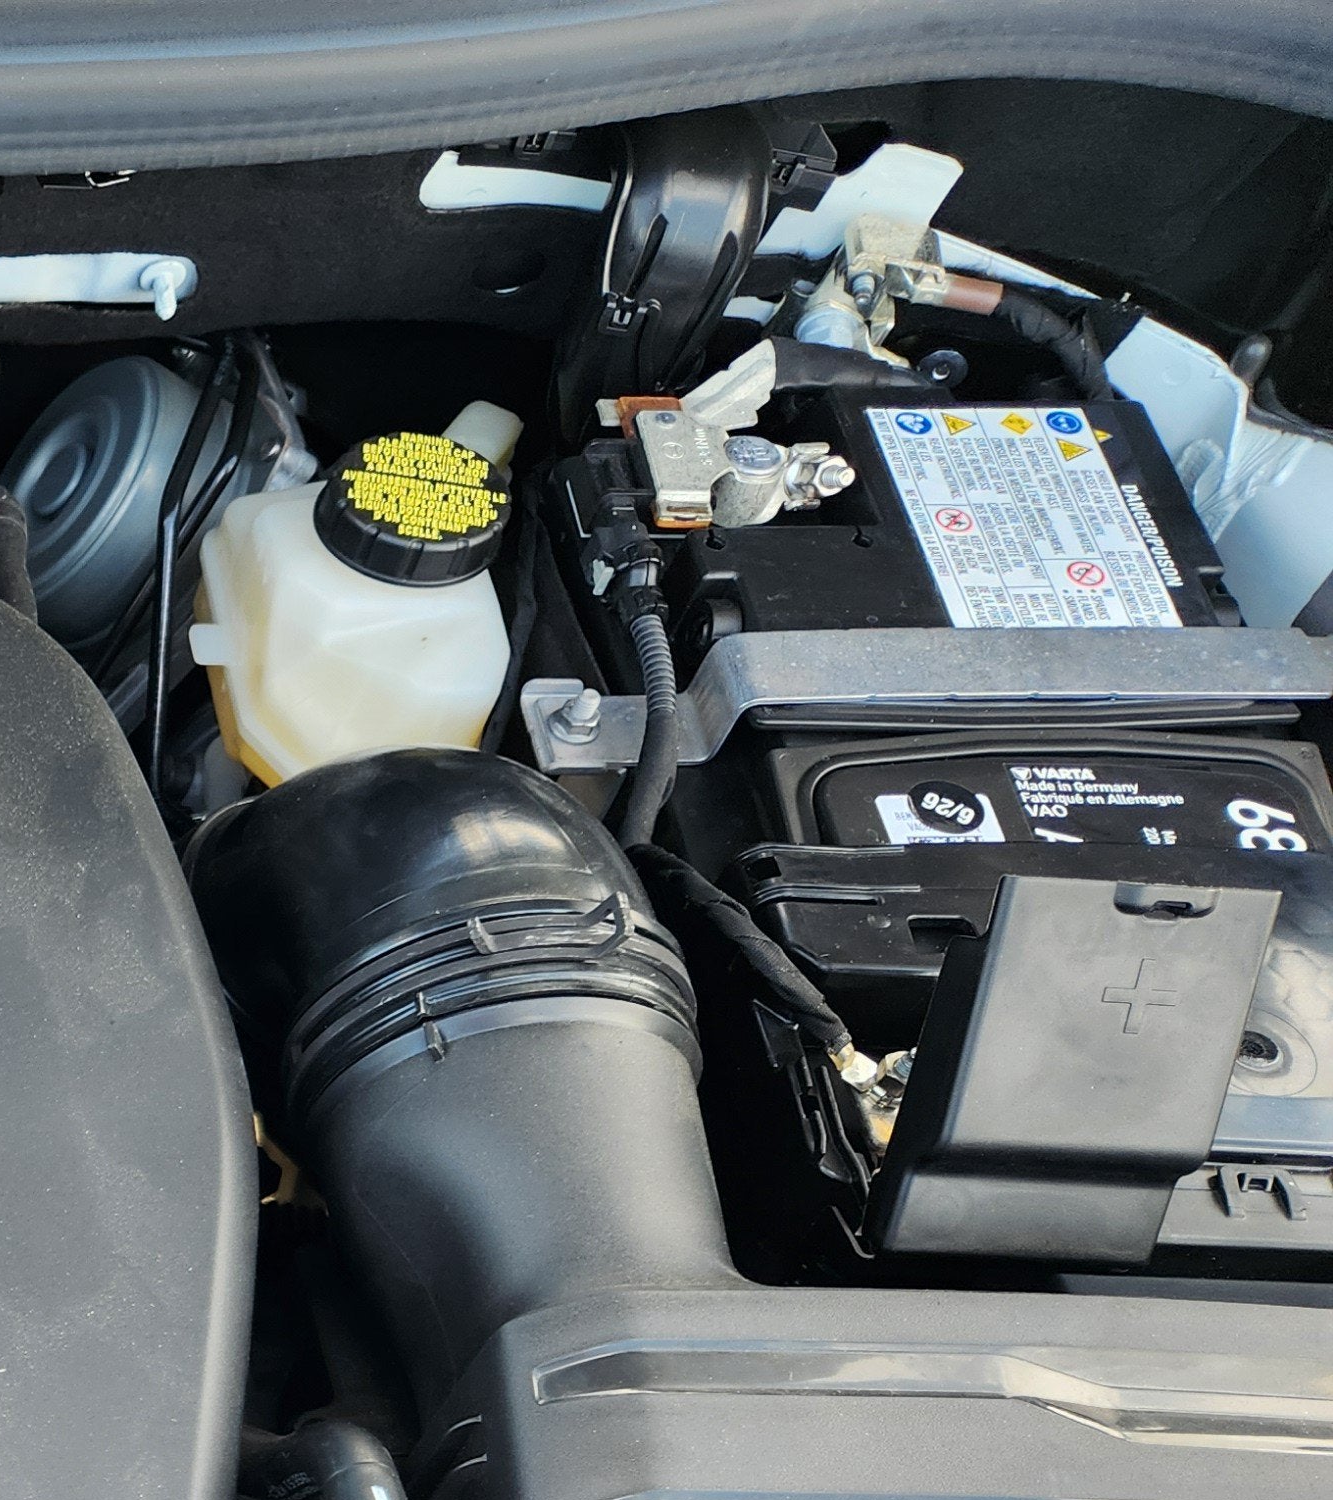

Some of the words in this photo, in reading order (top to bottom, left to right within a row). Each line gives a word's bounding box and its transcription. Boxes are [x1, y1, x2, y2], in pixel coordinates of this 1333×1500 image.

[492, 492, 507, 504] LE
[1118, 484, 1185, 587] DANGER/POISON
[1075, 595, 1097, 620] FLAMES
[1089, 595, 1111, 620] SPARKS
[1033, 767, 1096, 781] VARTA
[1015, 780, 1056, 792] Made
[1059, 781, 1072, 792] in
[1074, 782, 1139, 795] Germany
[921, 792, 975, 826] 6/26
[1020, 791, 1084, 806] Fabriqué
[1087, 795, 1105, 805] en
[1107, 794, 1184, 807] Allemagne
